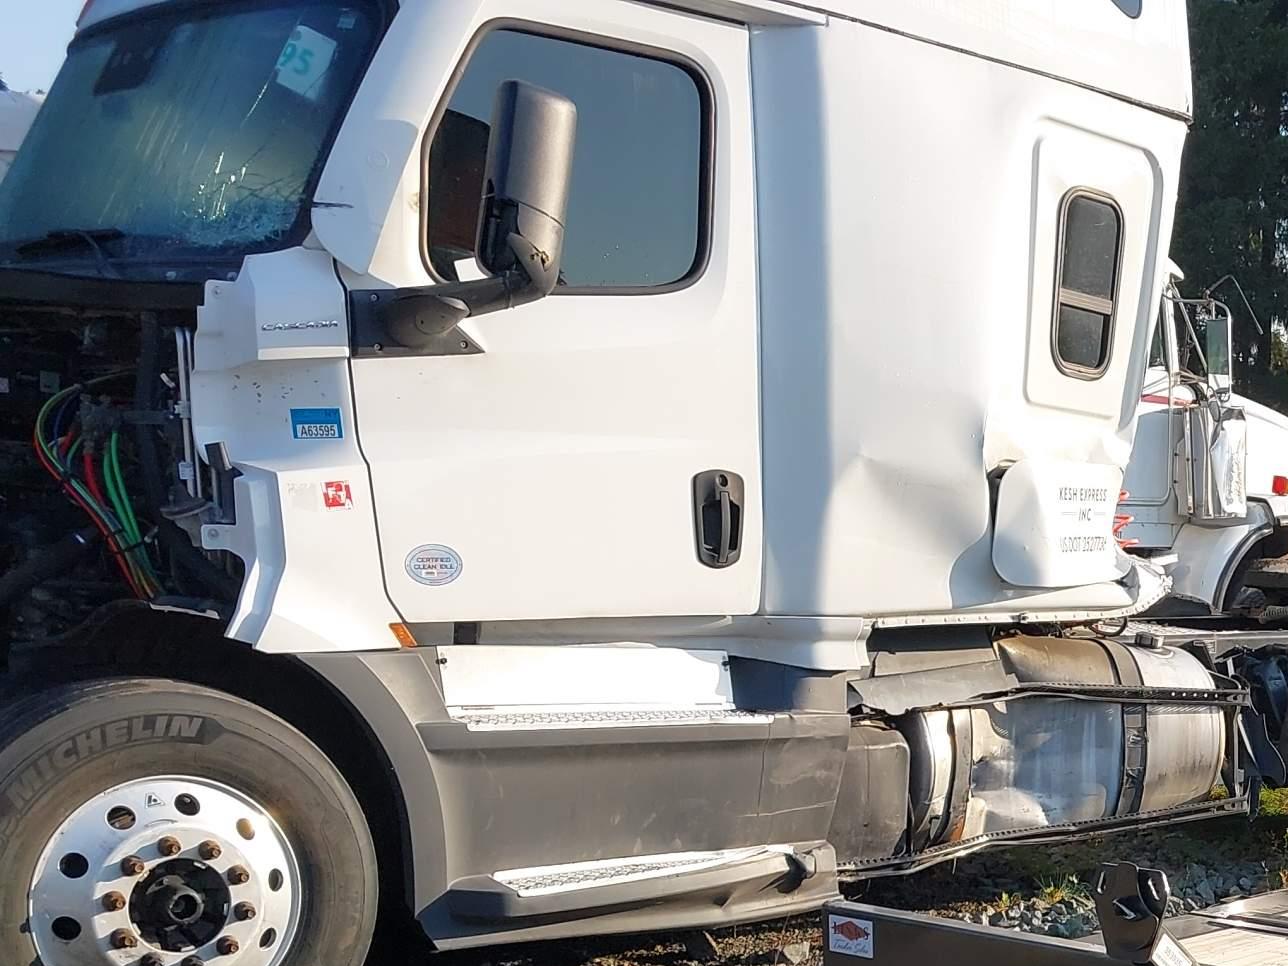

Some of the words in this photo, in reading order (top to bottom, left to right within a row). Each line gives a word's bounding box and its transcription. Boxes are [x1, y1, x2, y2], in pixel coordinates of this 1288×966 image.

[261, 319, 338, 332] CASCADIA
[301, 425, 336, 437] A63595
[1059, 487, 1078, 501] KESH
[1080, 488, 1108, 501] EXPRESS
[1079, 508, 1092, 522] INC
[7, 715, 203, 811] MICHELIN
